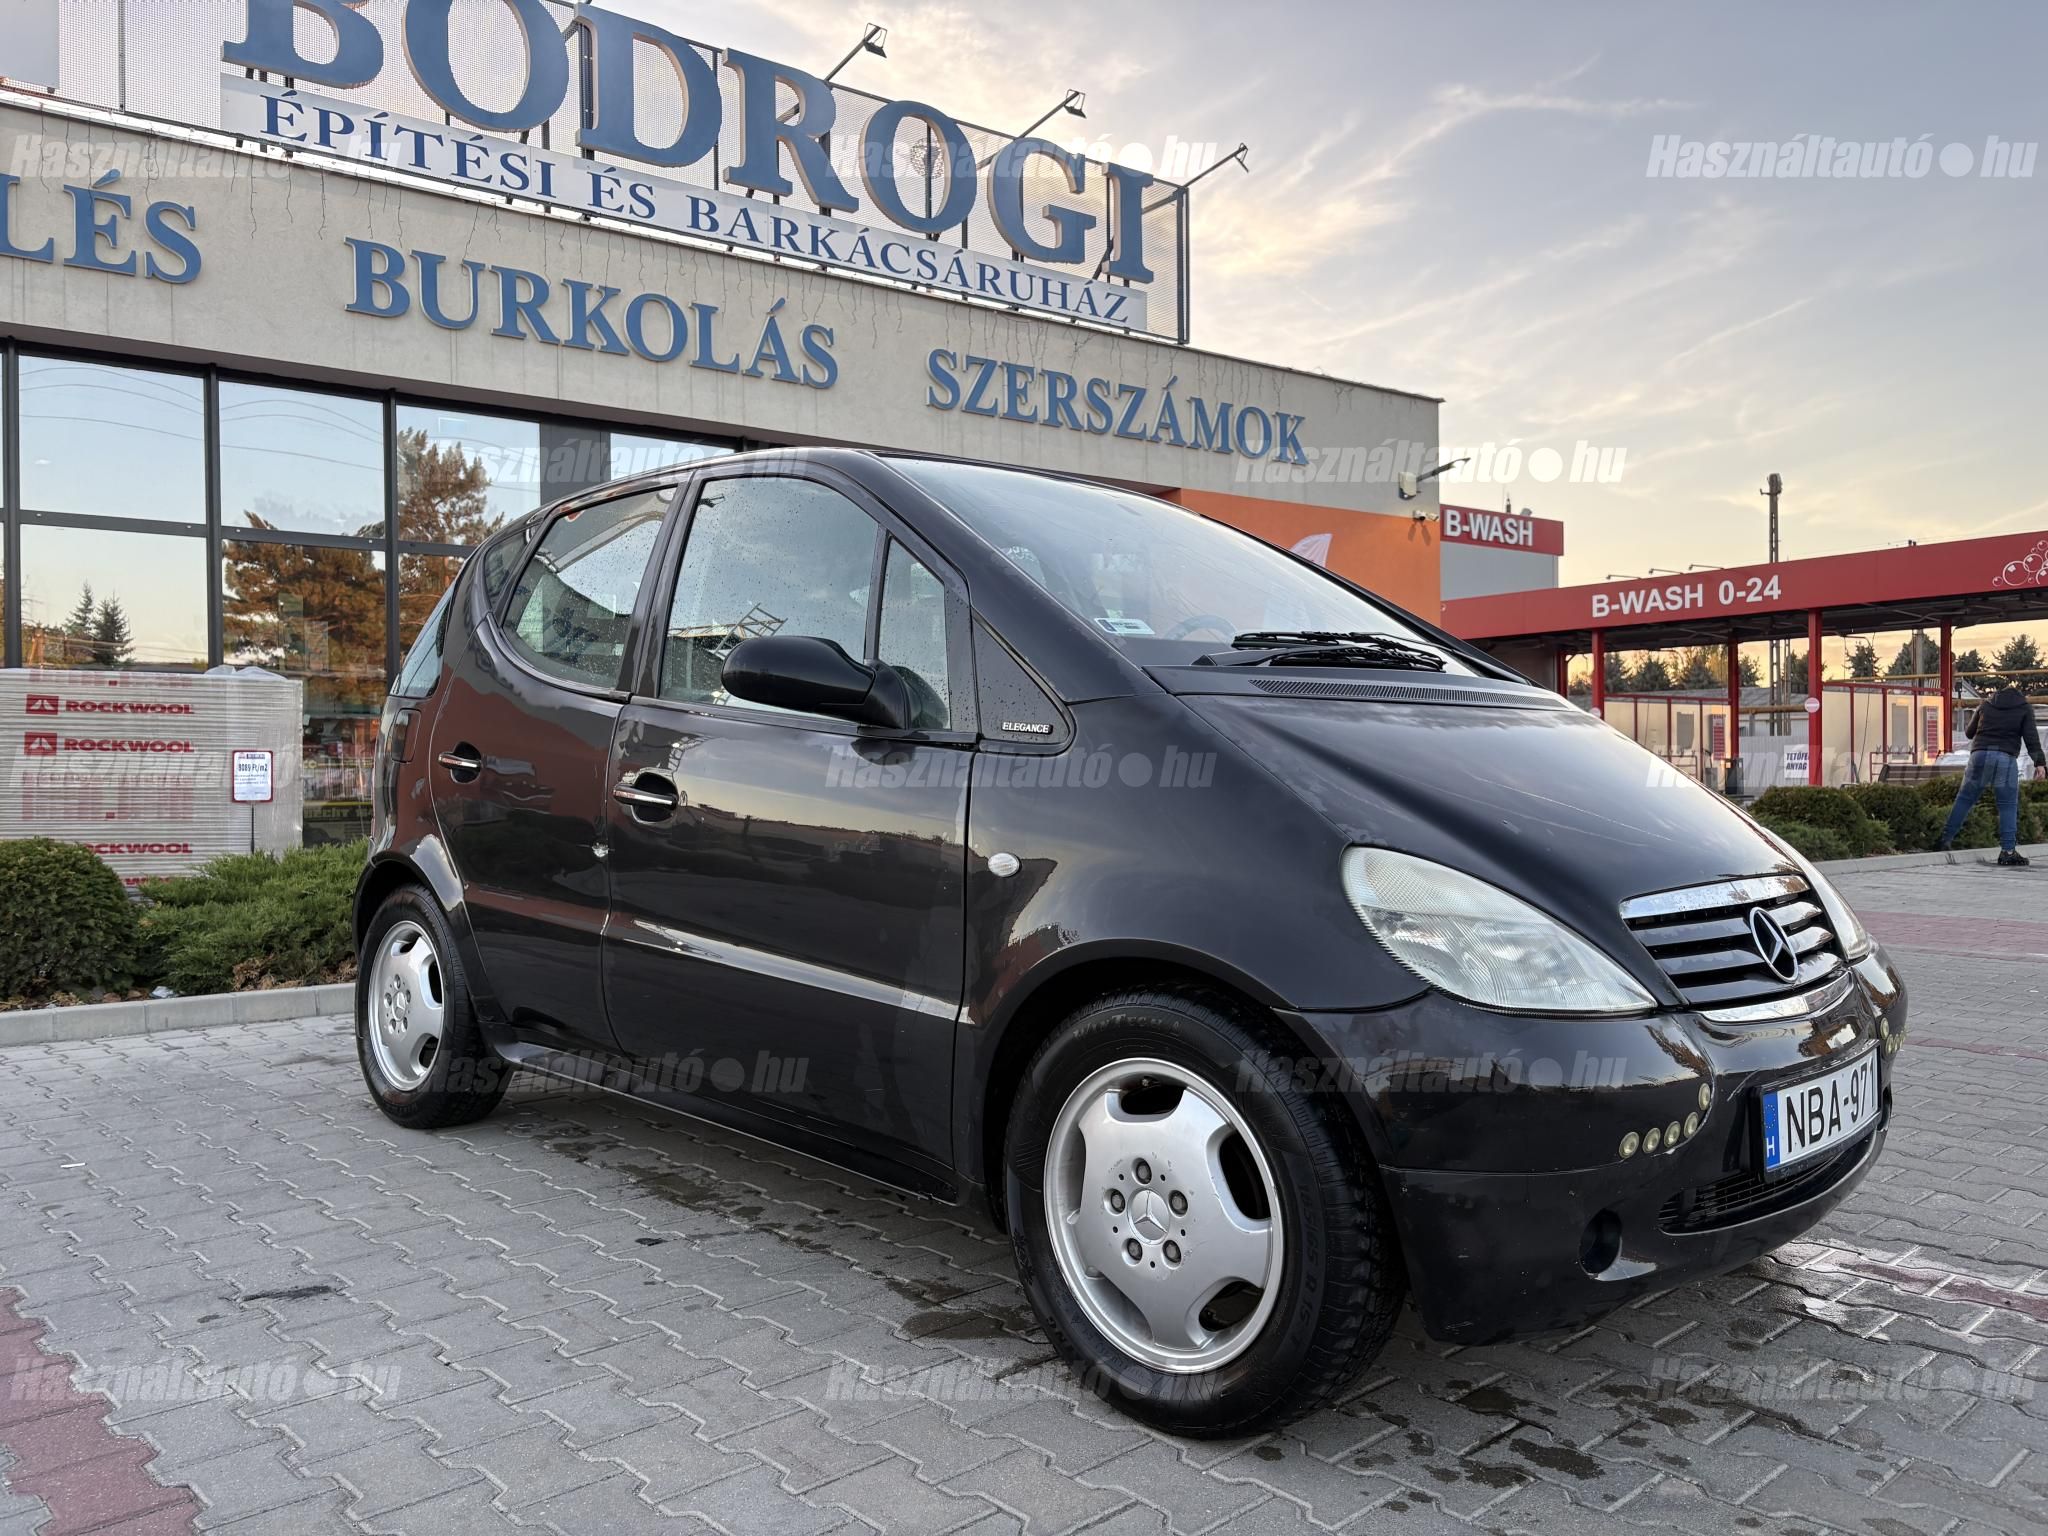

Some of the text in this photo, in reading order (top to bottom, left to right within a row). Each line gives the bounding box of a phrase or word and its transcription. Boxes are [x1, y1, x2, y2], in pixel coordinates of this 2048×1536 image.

[221, 0, 1155, 283] BODROGI
[260, 89, 1130, 325] ÉPÍTÉSI ÉS BARKÁCSÁRUHÁZ
[0, 168, 1310, 464] LÉS BURKOLÁS SZERSZÁMOK
[1444, 509, 1533, 546] B-WASH
[1592, 575, 1782, 618] B-WASH 0-24
[65, 700, 195, 714] ROCKWOOL
[1002, 722, 1050, 734] ELEGANCE
[64, 738, 195, 753] ROCKWOOL
[1786, 762, 1808, 771] ANYAG
[83, 843, 193, 855] CKWOOL
[1786, 1056, 1876, 1153] NBA-971
[1766, 1135, 1776, 1158] H
